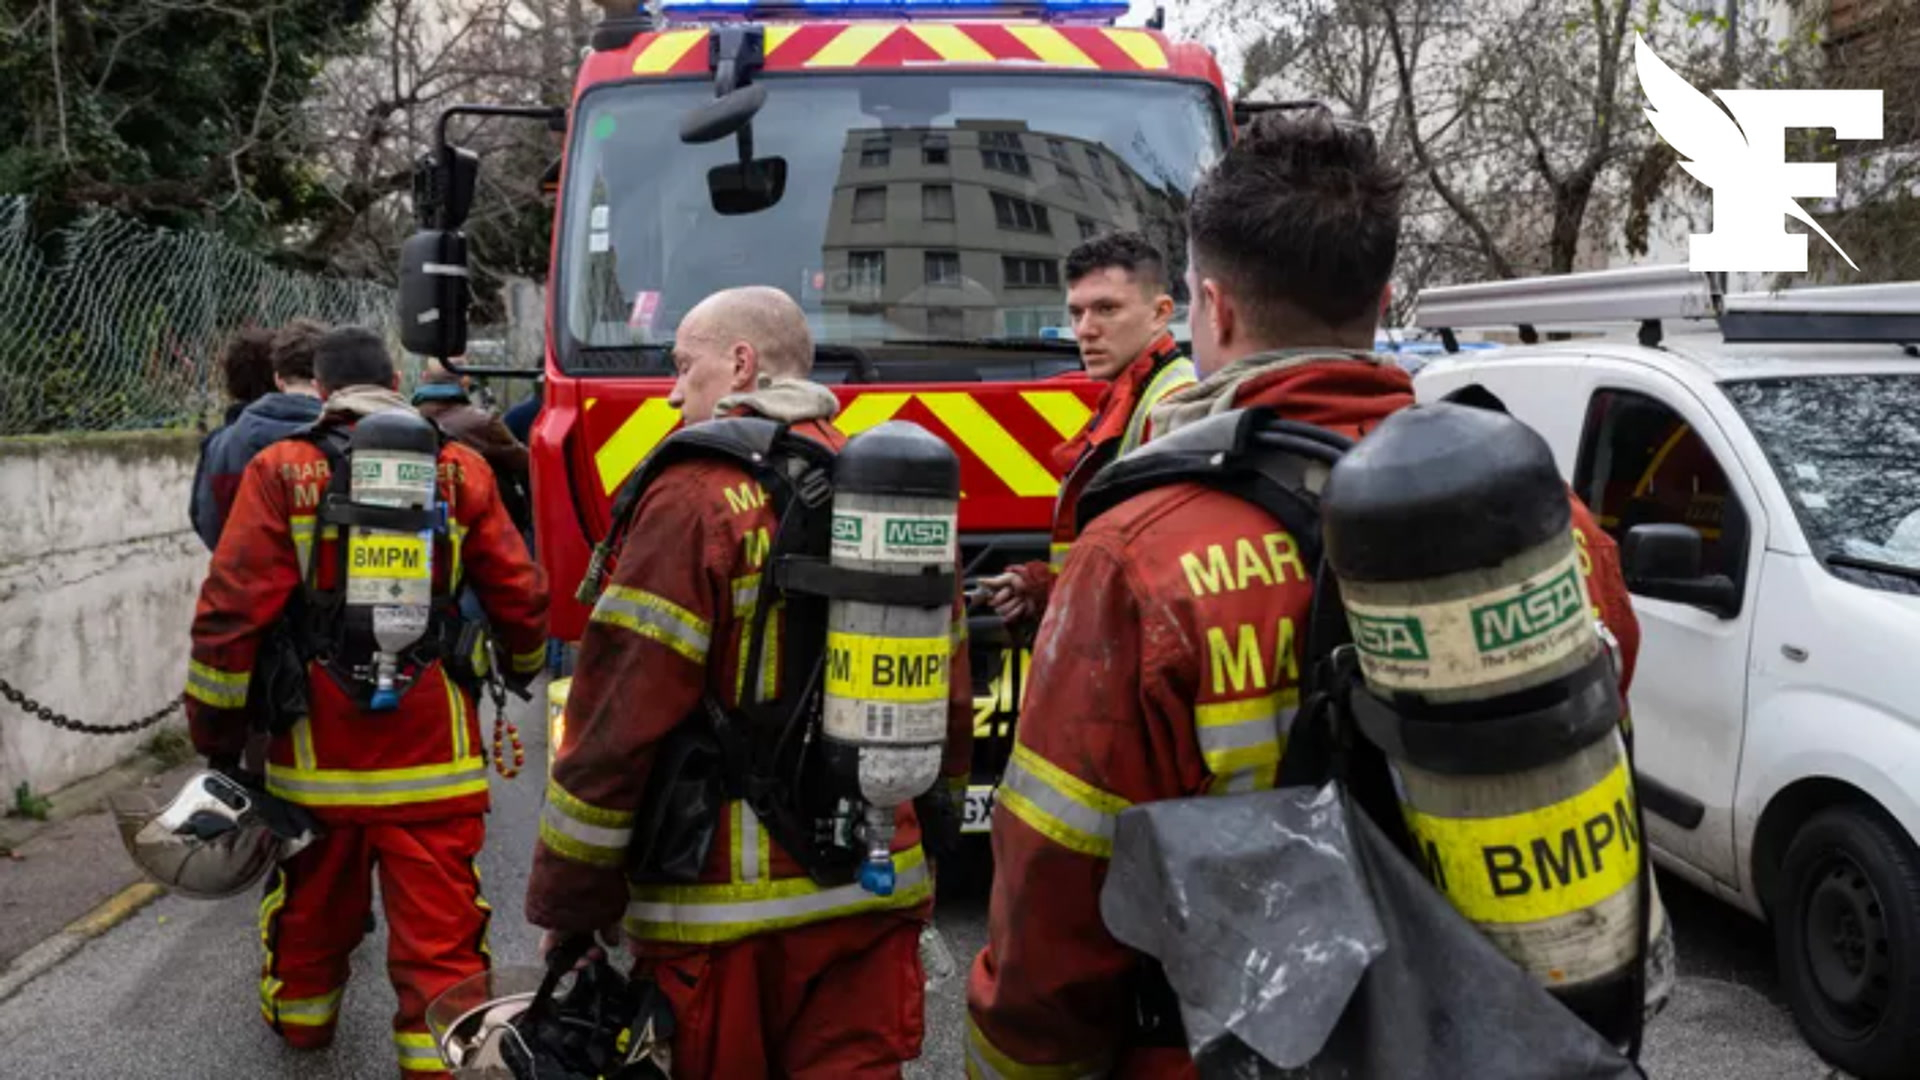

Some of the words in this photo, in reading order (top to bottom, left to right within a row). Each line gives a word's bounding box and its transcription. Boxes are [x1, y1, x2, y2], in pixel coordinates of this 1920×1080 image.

[887, 520, 947, 545] MSA
[353, 546, 420, 569] BMPM
[1479, 571, 1582, 647] MSA
